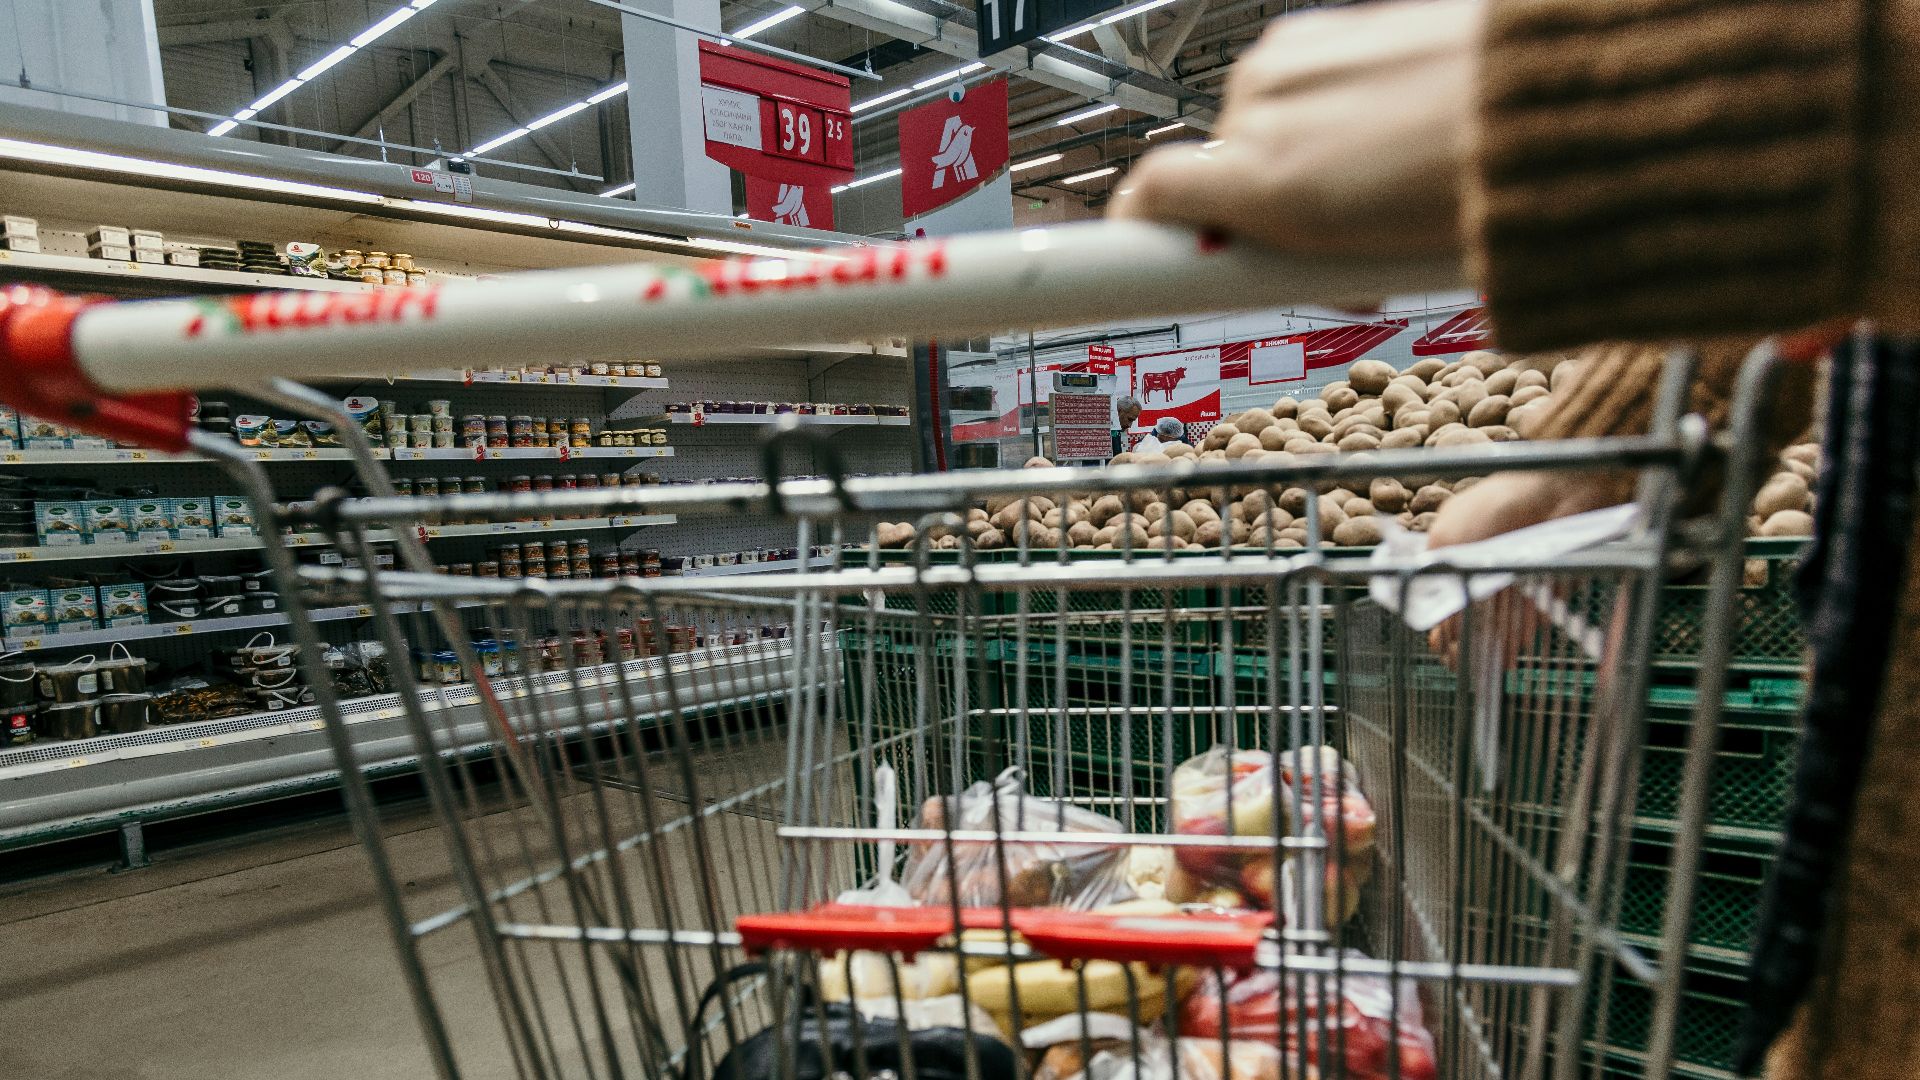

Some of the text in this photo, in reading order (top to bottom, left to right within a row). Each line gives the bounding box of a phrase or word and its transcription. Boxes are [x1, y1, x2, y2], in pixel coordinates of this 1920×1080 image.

[781, 108, 843, 155] 39 25
[415, 173, 431, 182] 120
